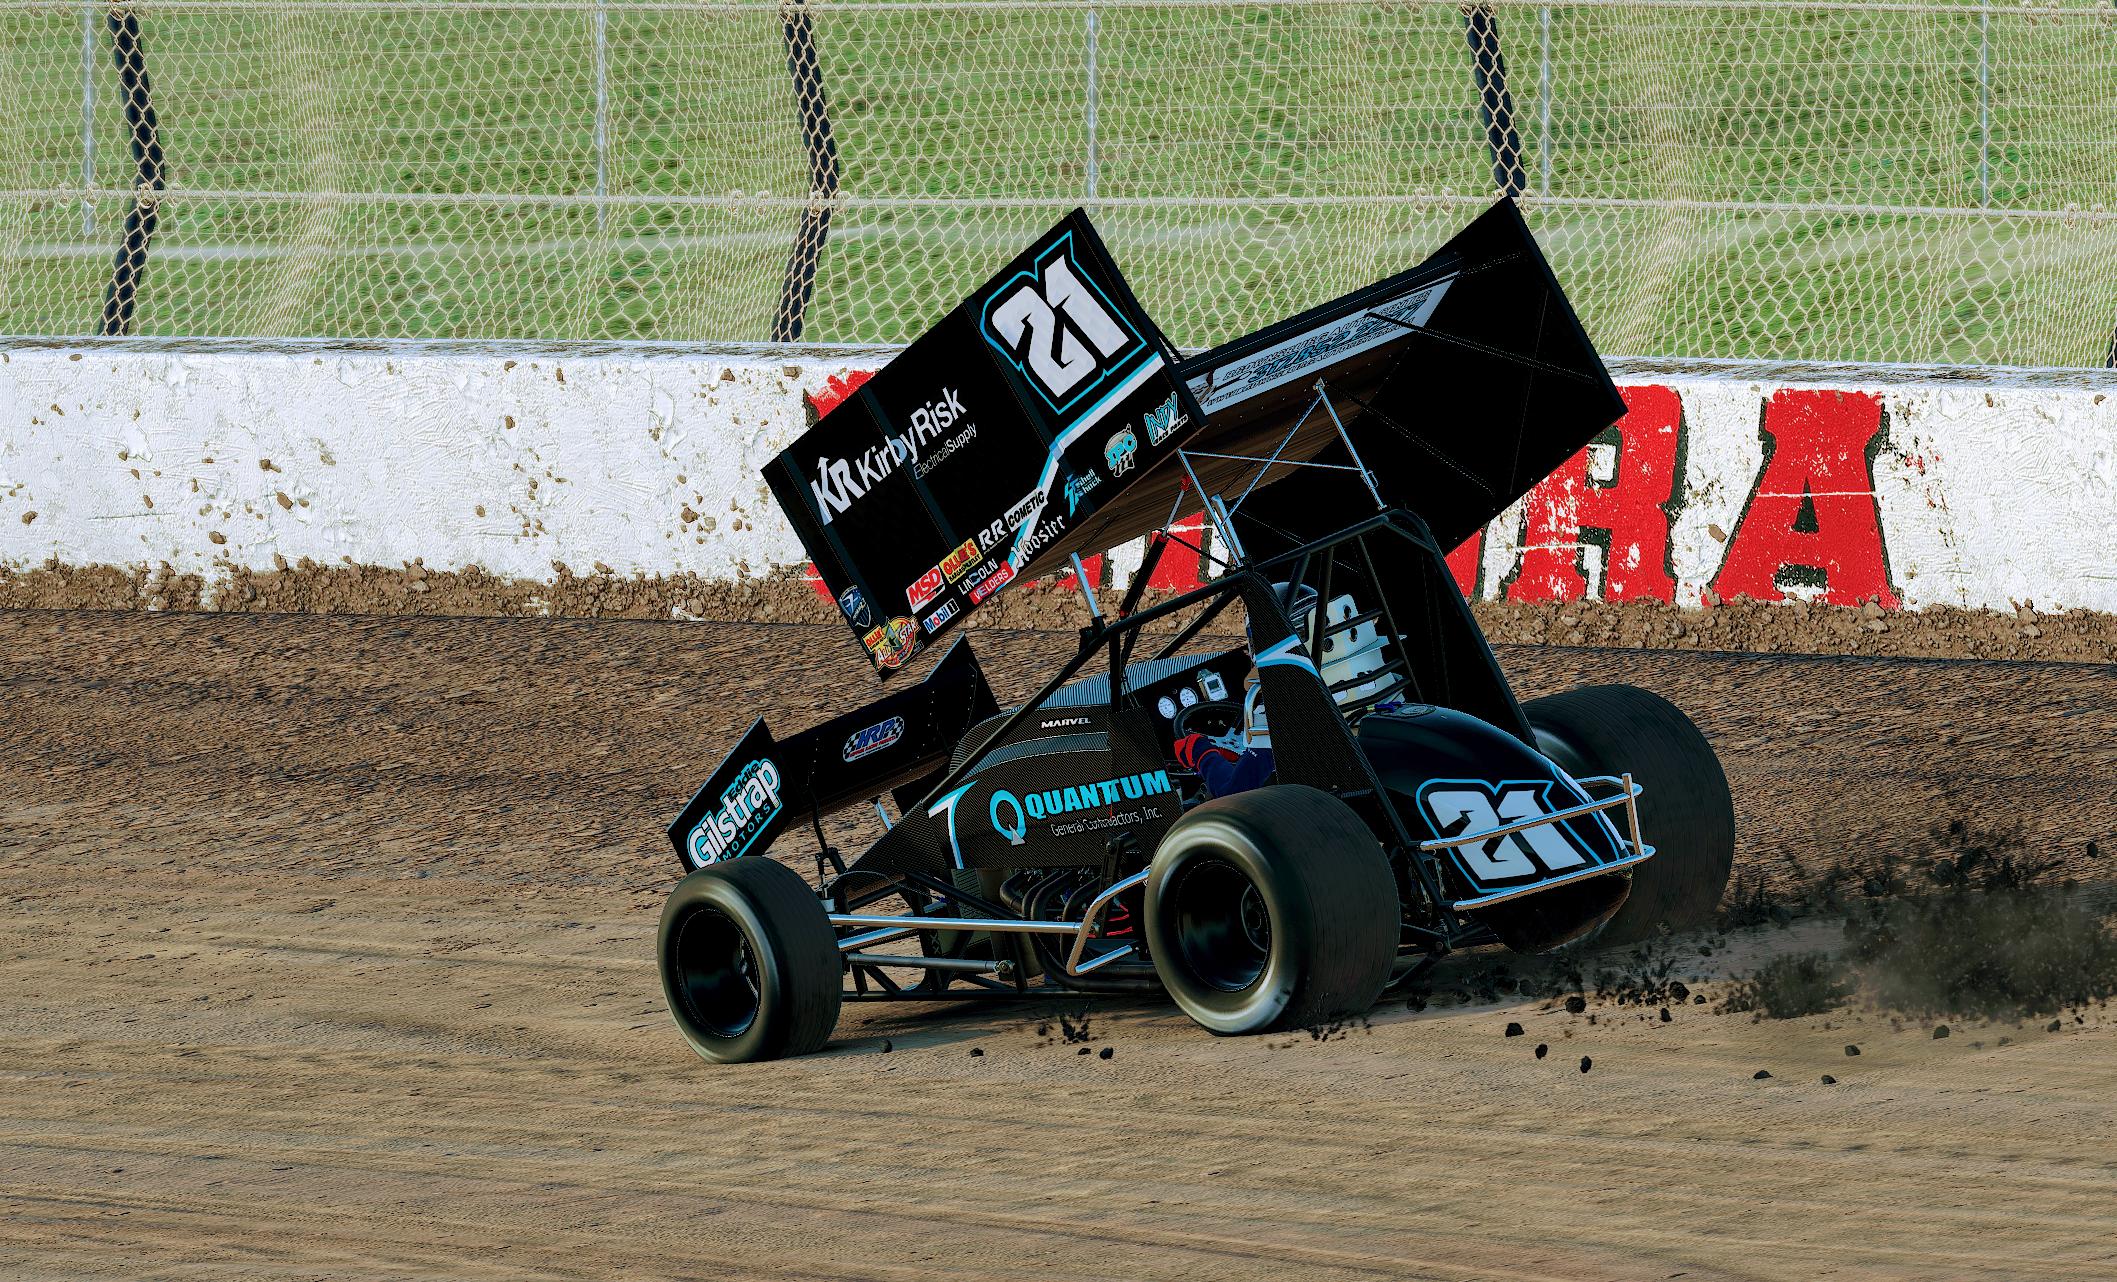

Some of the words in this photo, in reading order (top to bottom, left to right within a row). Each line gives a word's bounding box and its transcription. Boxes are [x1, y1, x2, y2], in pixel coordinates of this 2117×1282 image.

[992, 255, 1130, 398] 21
[1007, 490, 1045, 528] COMETIC
[1010, 514, 1066, 568] Hoosier
[910, 567, 941, 606] MSD
[958, 558, 998, 596] LINCOLN
[924, 606, 950, 632] Mobil
[1041, 717, 1091, 729] MARVEL
[689, 761, 780, 869] Gilstrap
[1024, 769, 1172, 820] QUANTUM
[1142, 806, 1163, 820] Inc.
[722, 802, 771, 861] MOTORS
[1427, 790, 1587, 881] 21
